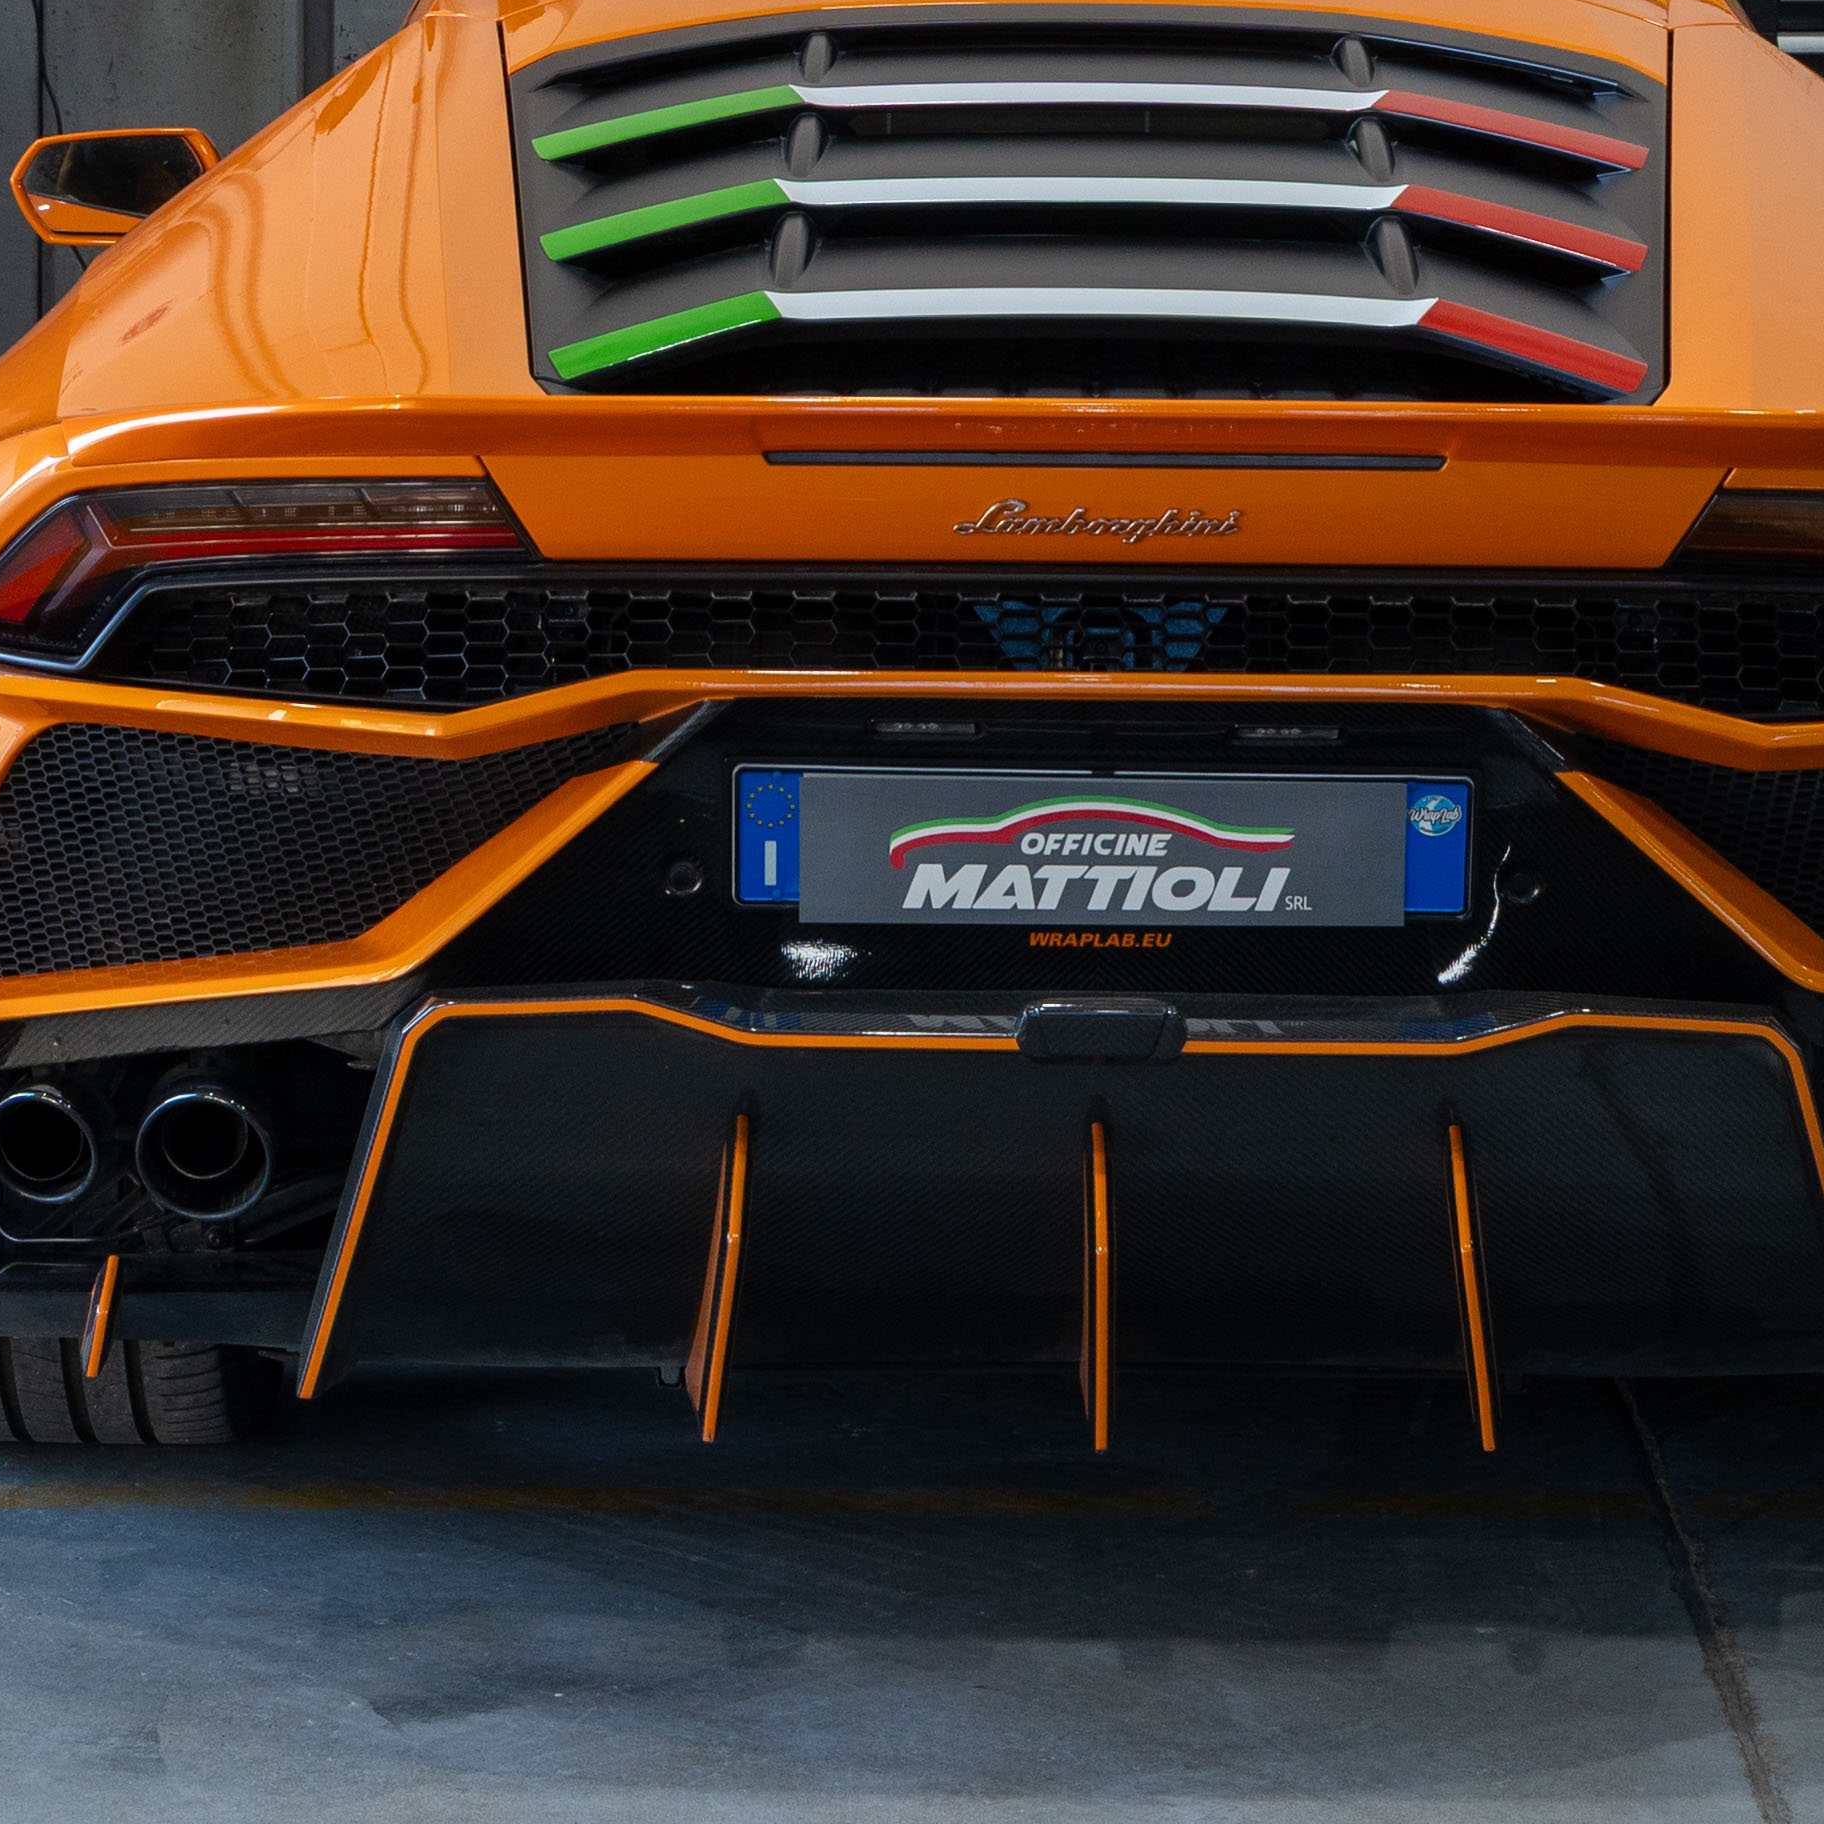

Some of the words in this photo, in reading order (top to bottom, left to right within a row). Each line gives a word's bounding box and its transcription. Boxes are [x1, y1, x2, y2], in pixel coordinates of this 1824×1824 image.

[952, 497, 1242, 544] Lamborghini
[1020, 832, 1174, 857] OFFICINE
[902, 863, 1292, 912] MATTIOLI
[1285, 895, 1313, 911] SRL
[1029, 931, 1174, 948] WRAPLAB.EU
